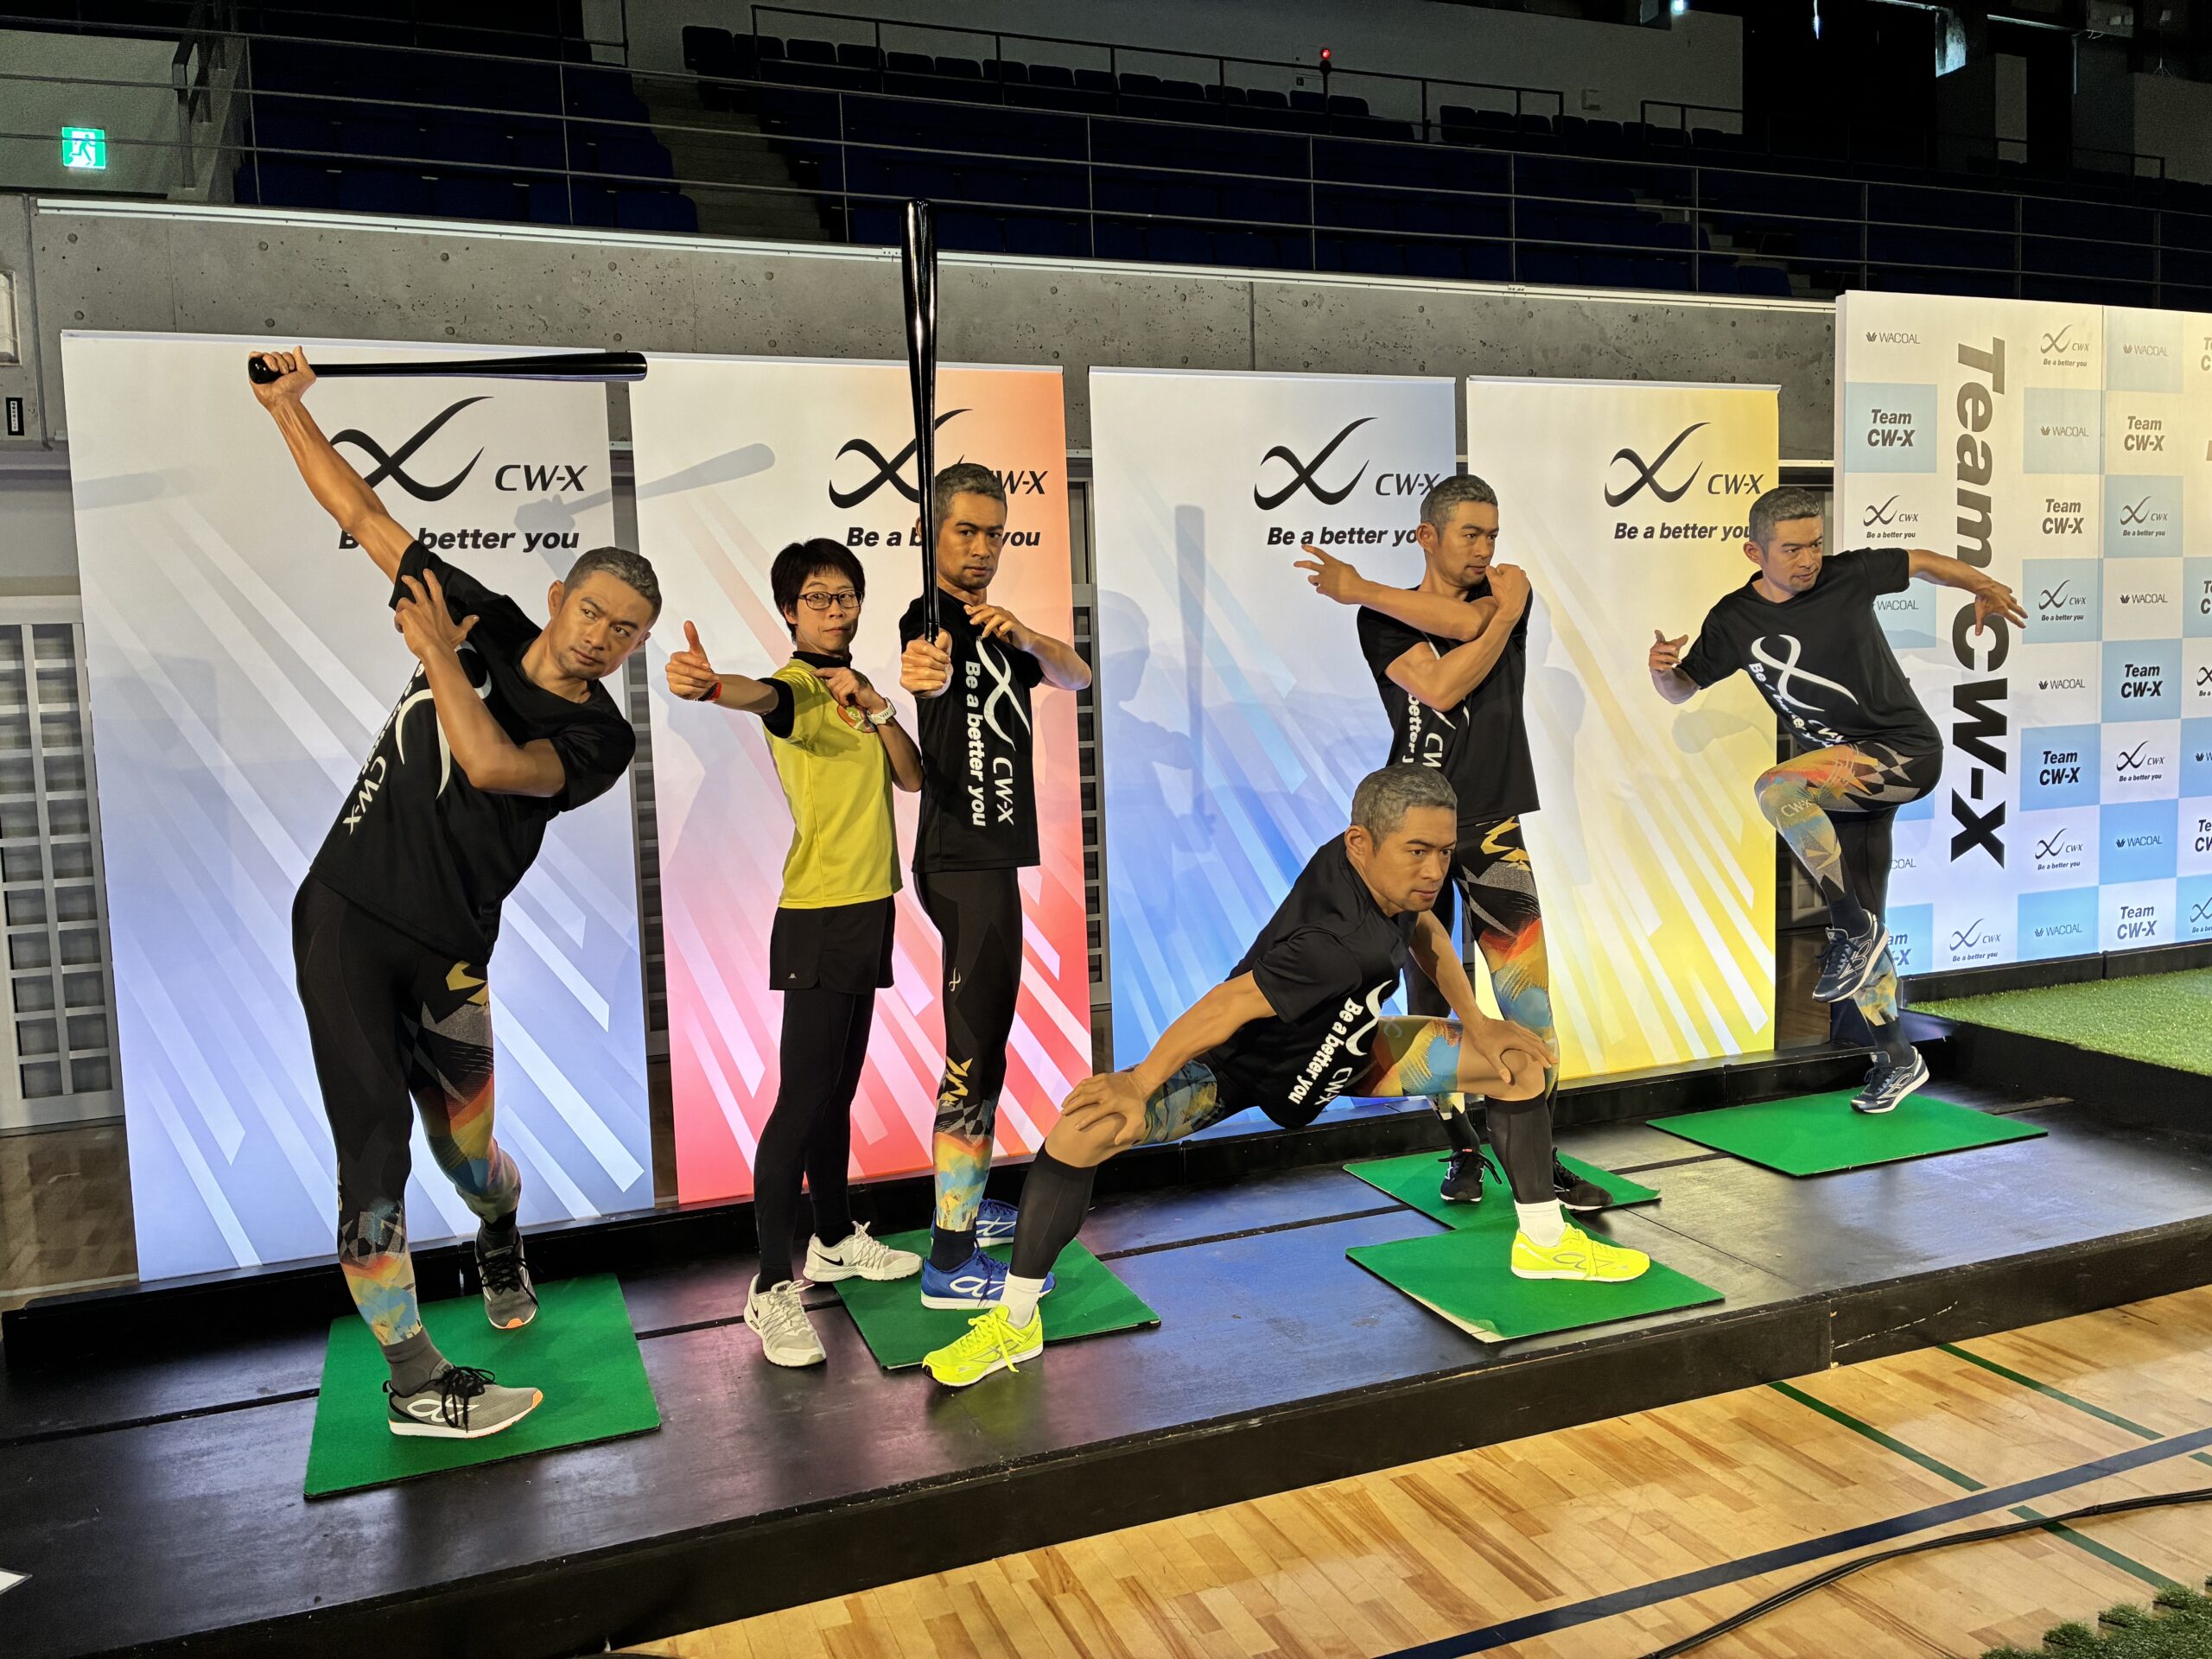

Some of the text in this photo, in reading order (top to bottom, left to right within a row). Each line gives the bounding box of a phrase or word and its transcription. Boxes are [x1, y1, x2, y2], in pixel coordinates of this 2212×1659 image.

[1878, 332, 1920, 344] WACOAL
[2072, 342, 2089, 352] CW-X
[2133, 345, 2169, 357] WACOAL
[1871, 409, 1912, 424] Team
[2127, 416, 2162, 431] Team
[1867, 429, 1915, 447] CW-X
[2052, 426, 2089, 437] WACOAL
[2124, 434, 2165, 451] CW-X
[495, 465, 588, 492] CW-X
[1376, 474, 1440, 496] CW-X
[1707, 474, 1764, 494] CW-X
[2045, 499, 2082, 513] Team
[1898, 513, 1919, 522] CW-X
[2042, 517, 2084, 534] CW-X
[846, 527, 880, 547] Be
[887, 531, 902, 547] a
[1268, 527, 1417, 547] Be a better yo
[1614, 522, 1638, 539] Be
[1643, 526, 1655, 539] a
[1659, 522, 1718, 539] better
[339, 527, 580, 553] B better you
[1877, 600, 1919, 611] WACOAL
[1950, 337, 2009, 869] Team CW-X
[2069, 597, 2087, 606] CW-X
[2132, 593, 2168, 604] WACOAL
[1748, 663, 1767, 682] Be
[2125, 664, 2160, 677] Team
[2050, 678, 2086, 690] WACOAL
[2120, 680, 2164, 698] CW-X
[965, 660, 987, 827] Be a better you
[2043, 750, 2078, 765] Team
[2146, 756, 2165, 766] CW-X
[2039, 766, 2081, 785] CW-X
[342, 756, 387, 836] CW-X
[993, 757, 1014, 826] CW-X
[2065, 844, 2083, 853] CW-X
[2126, 835, 2163, 848] WACOAL
[2120, 906, 2155, 919] Team
[2046, 924, 2082, 937] WACOAL
[2117, 919, 2158, 940] CW-X
[1982, 934, 2001, 944] CW-X
[1287, 996, 1364, 1105] Be a better you
[1314, 1067, 1353, 1105] CW-X
